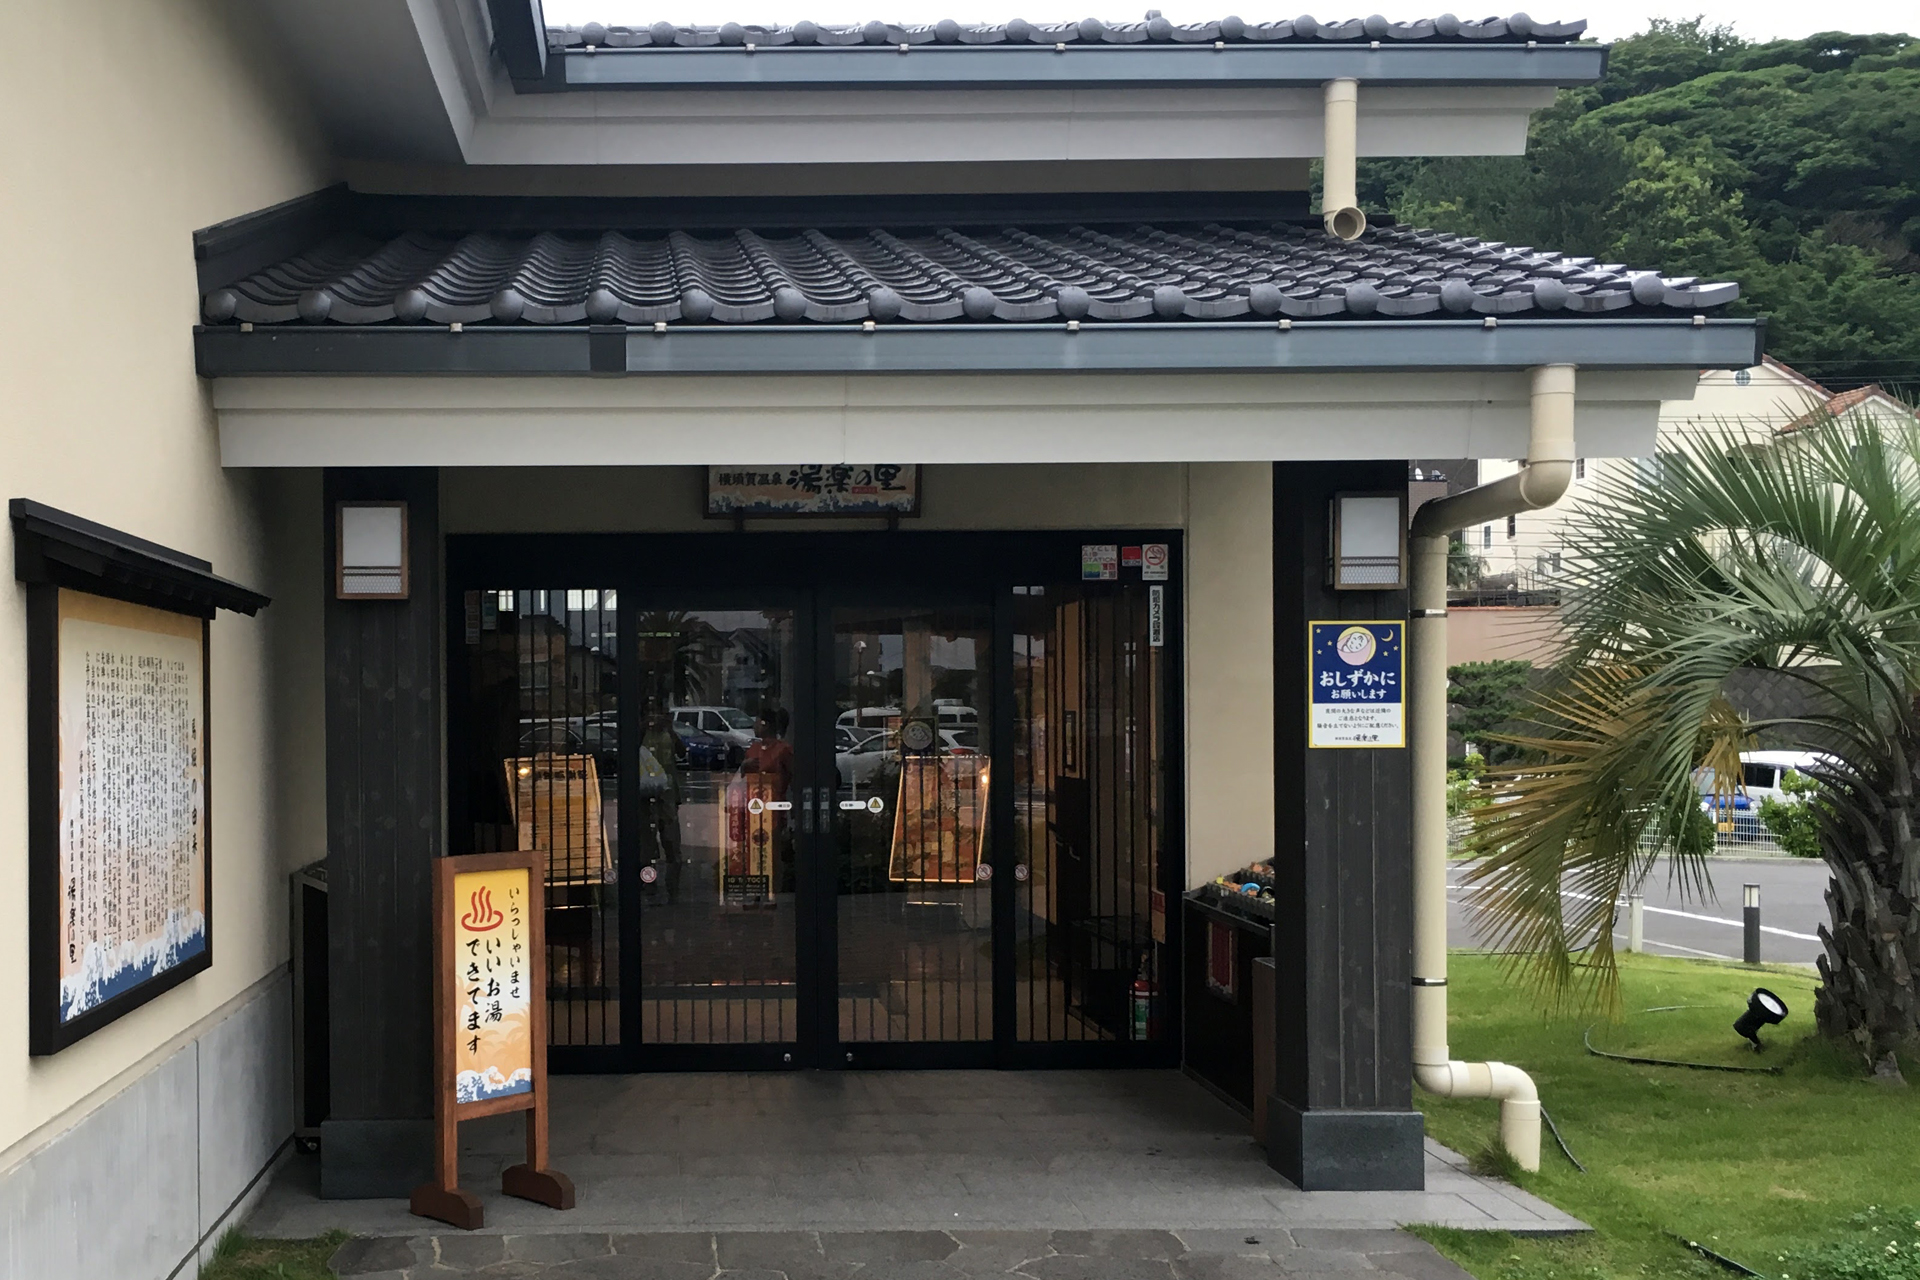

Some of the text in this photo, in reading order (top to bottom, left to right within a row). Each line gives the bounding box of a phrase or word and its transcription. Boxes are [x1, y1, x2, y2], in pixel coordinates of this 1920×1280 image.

[719, 472, 782, 486] 横須賀温泉
[1320, 669, 1396, 687] おしずかに
[1331, 689, 1387, 700] お願いします
[509, 887, 521, 999] いらっしゃいませ
[466, 938, 481, 1056] できてます
[484, 937, 502, 1024] いいお湯
